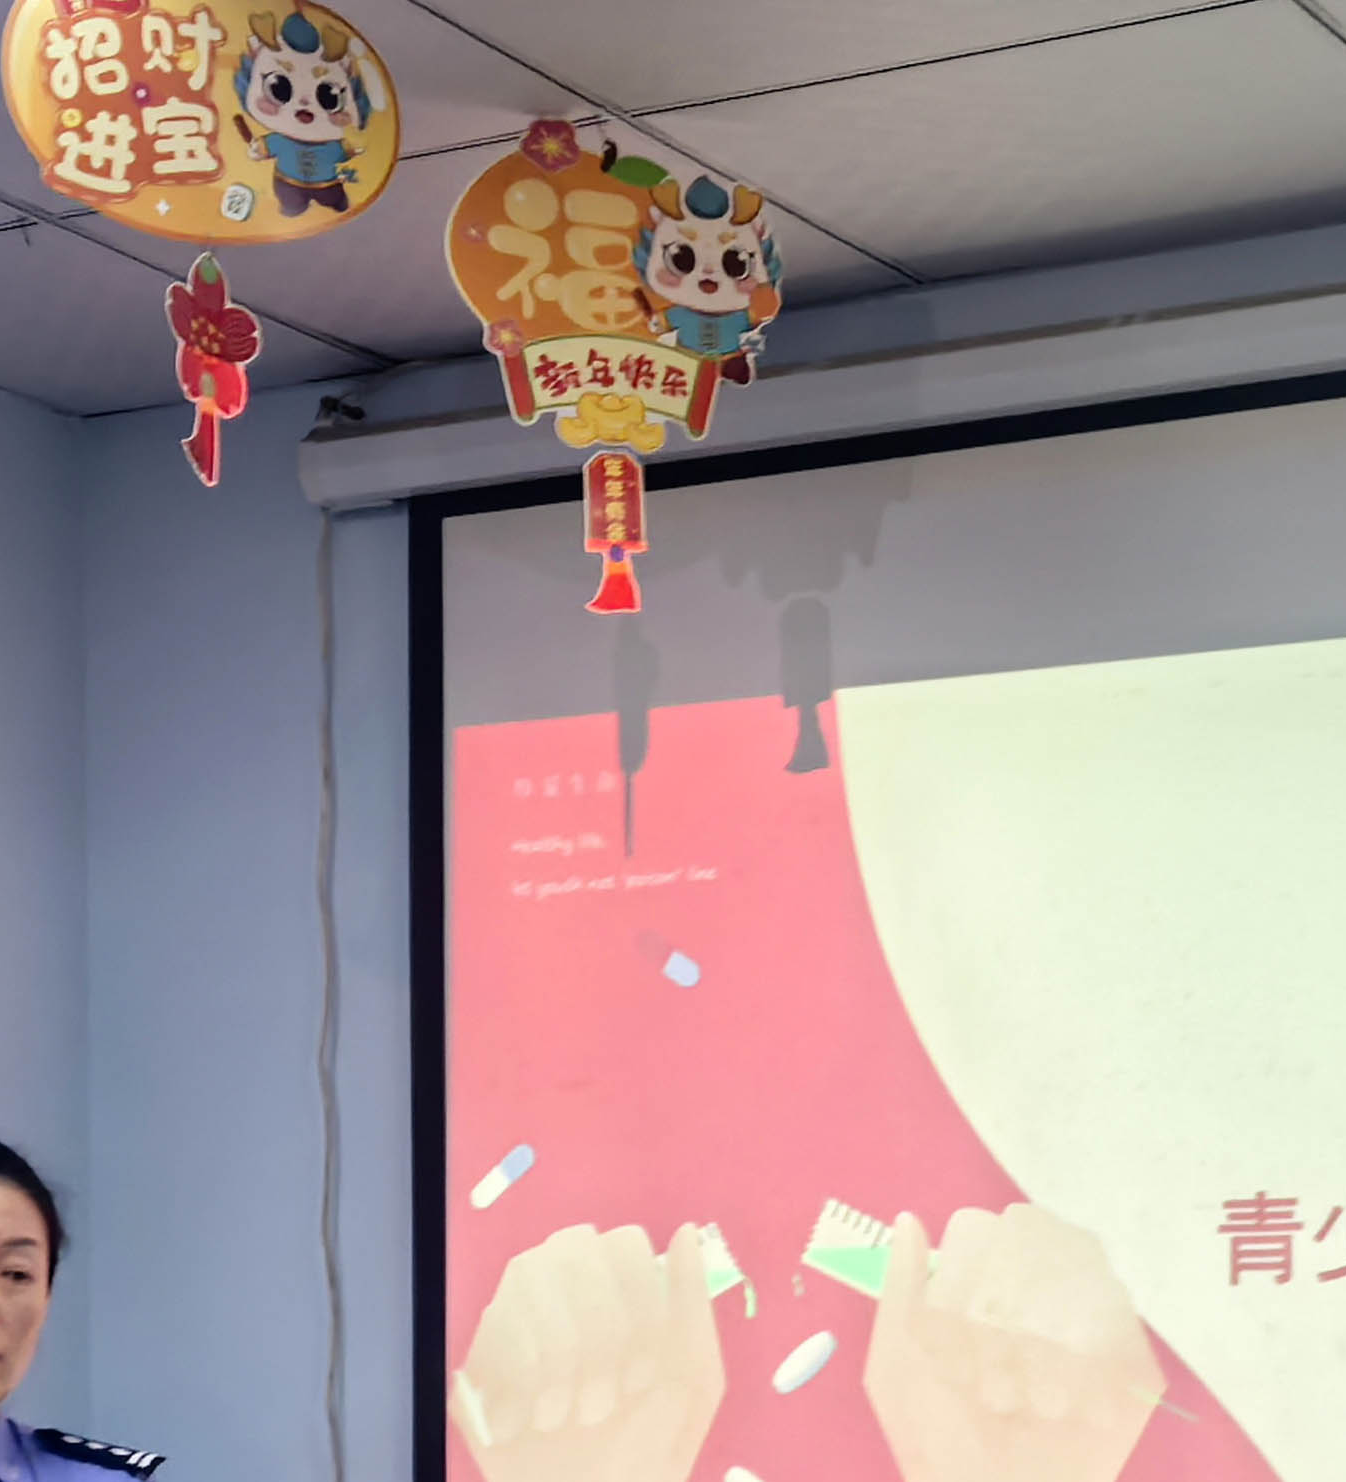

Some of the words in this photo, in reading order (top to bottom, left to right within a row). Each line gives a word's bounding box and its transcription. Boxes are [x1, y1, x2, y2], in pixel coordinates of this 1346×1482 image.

[46, 10, 224, 99] 招财
[53, 97, 219, 194] 进宝
[486, 177, 645, 332] 福
[533, 349, 689, 397] 新年快乐
